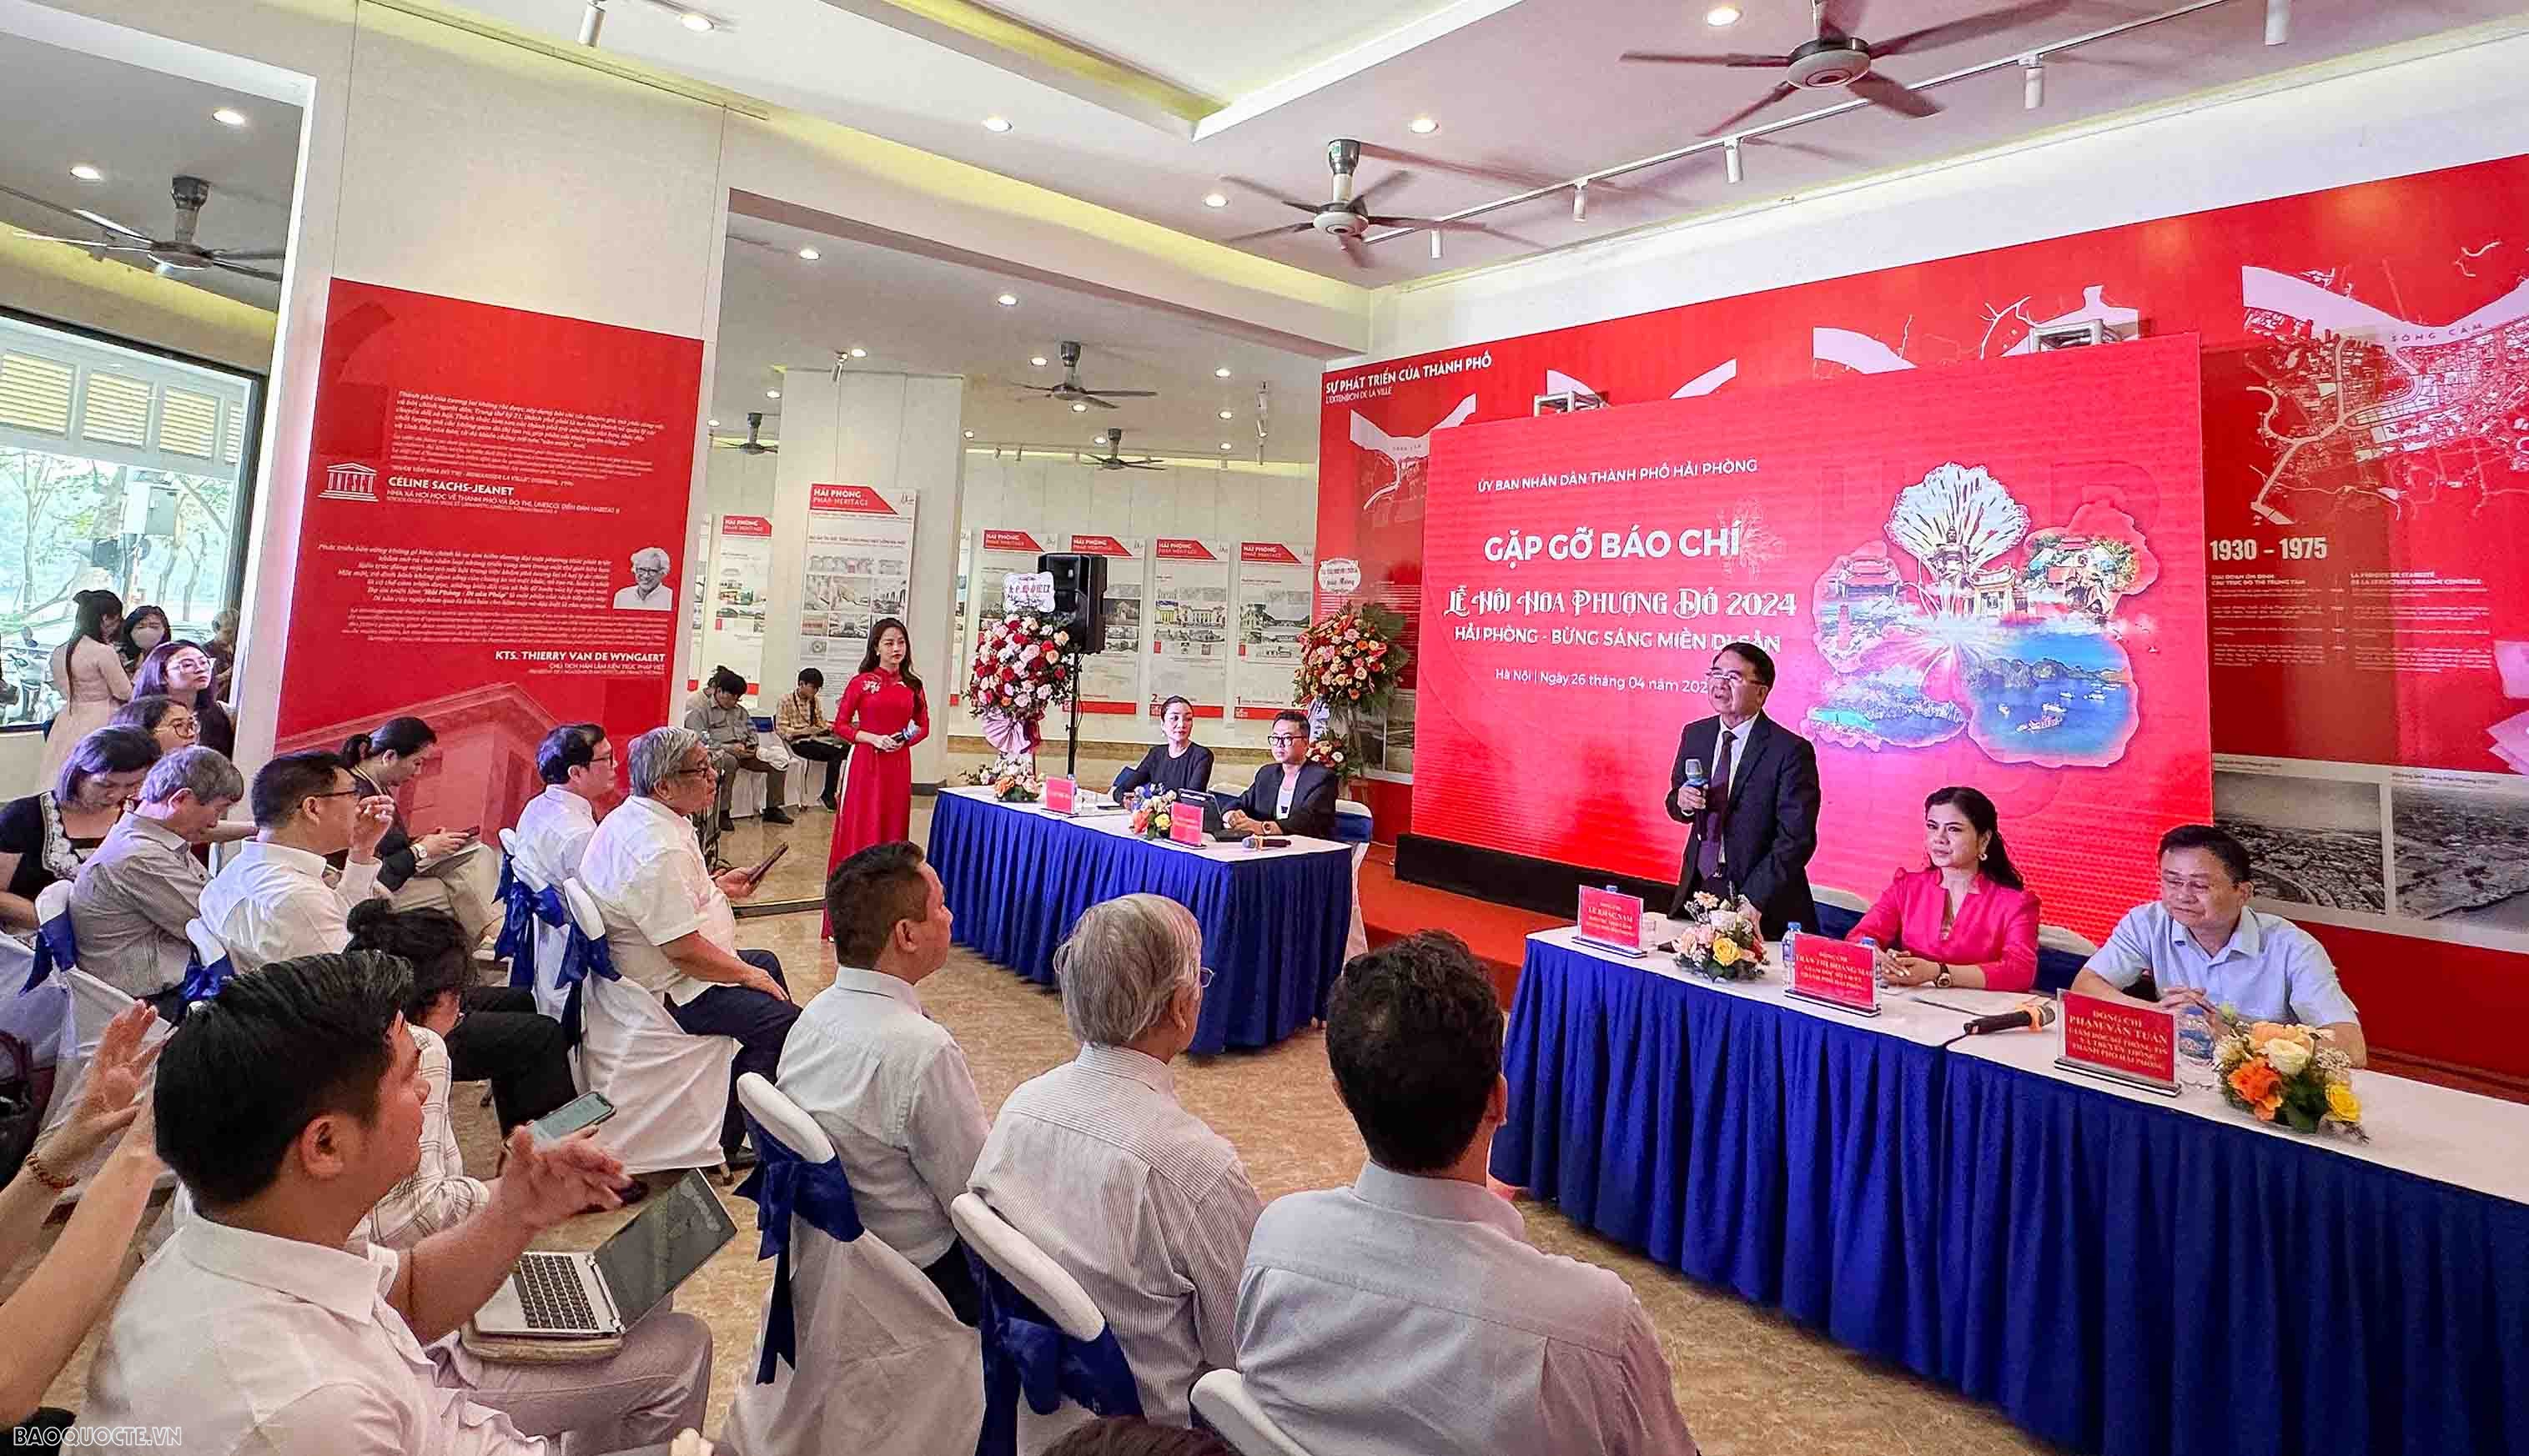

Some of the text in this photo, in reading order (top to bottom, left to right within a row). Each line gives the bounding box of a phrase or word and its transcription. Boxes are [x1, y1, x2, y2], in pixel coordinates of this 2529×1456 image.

[1340, 375, 1365, 392] PHÁT
[1423, 360, 1463, 378] THÀNH
[431, 479, 515, 496] SACHS-JEANET
[1495, 479, 1520, 491] BAN
[1521, 474, 1557, 489] NHÂN
[1560, 470, 1587, 486] DÂN
[1590, 467, 1637, 484] THÀNH
[1640, 461, 1670, 480] PHỐ
[1673, 460, 1698, 477] HẢI
[1702, 458, 1757, 474] PHÒNG
[1484, 520, 1742, 570] GẶP GỠ BÁO CHÍ
[2210, 539, 2257, 560] 1930
[2279, 536, 2327, 560] 1975
[1725, 591, 1797, 617] 2024
[1455, 622, 1481, 641] HẢI
[1483, 625, 1538, 644] PHÒNG
[1551, 625, 1599, 646] BỪNG
[1603, 627, 1653, 648] SÁNG
[1657, 627, 1707, 650] MIỀN
[520, 650, 567, 661] THIERRY
[568, 651, 592, 661] VAN
[595, 652, 608, 661] DE
[610, 652, 666, 662] WYNGAERT
[1495, 667, 1511, 680] Hà
[1513, 668, 1531, 684] Nội
[1540, 670, 1569, 687] Ngày
[1571, 673, 1586, 685] 26
[1588, 673, 1625, 690] tháng
[1627, 676, 1646, 689] 04
[1648, 678, 1679, 692] năm
[1681, 680, 1709, 695] 202
